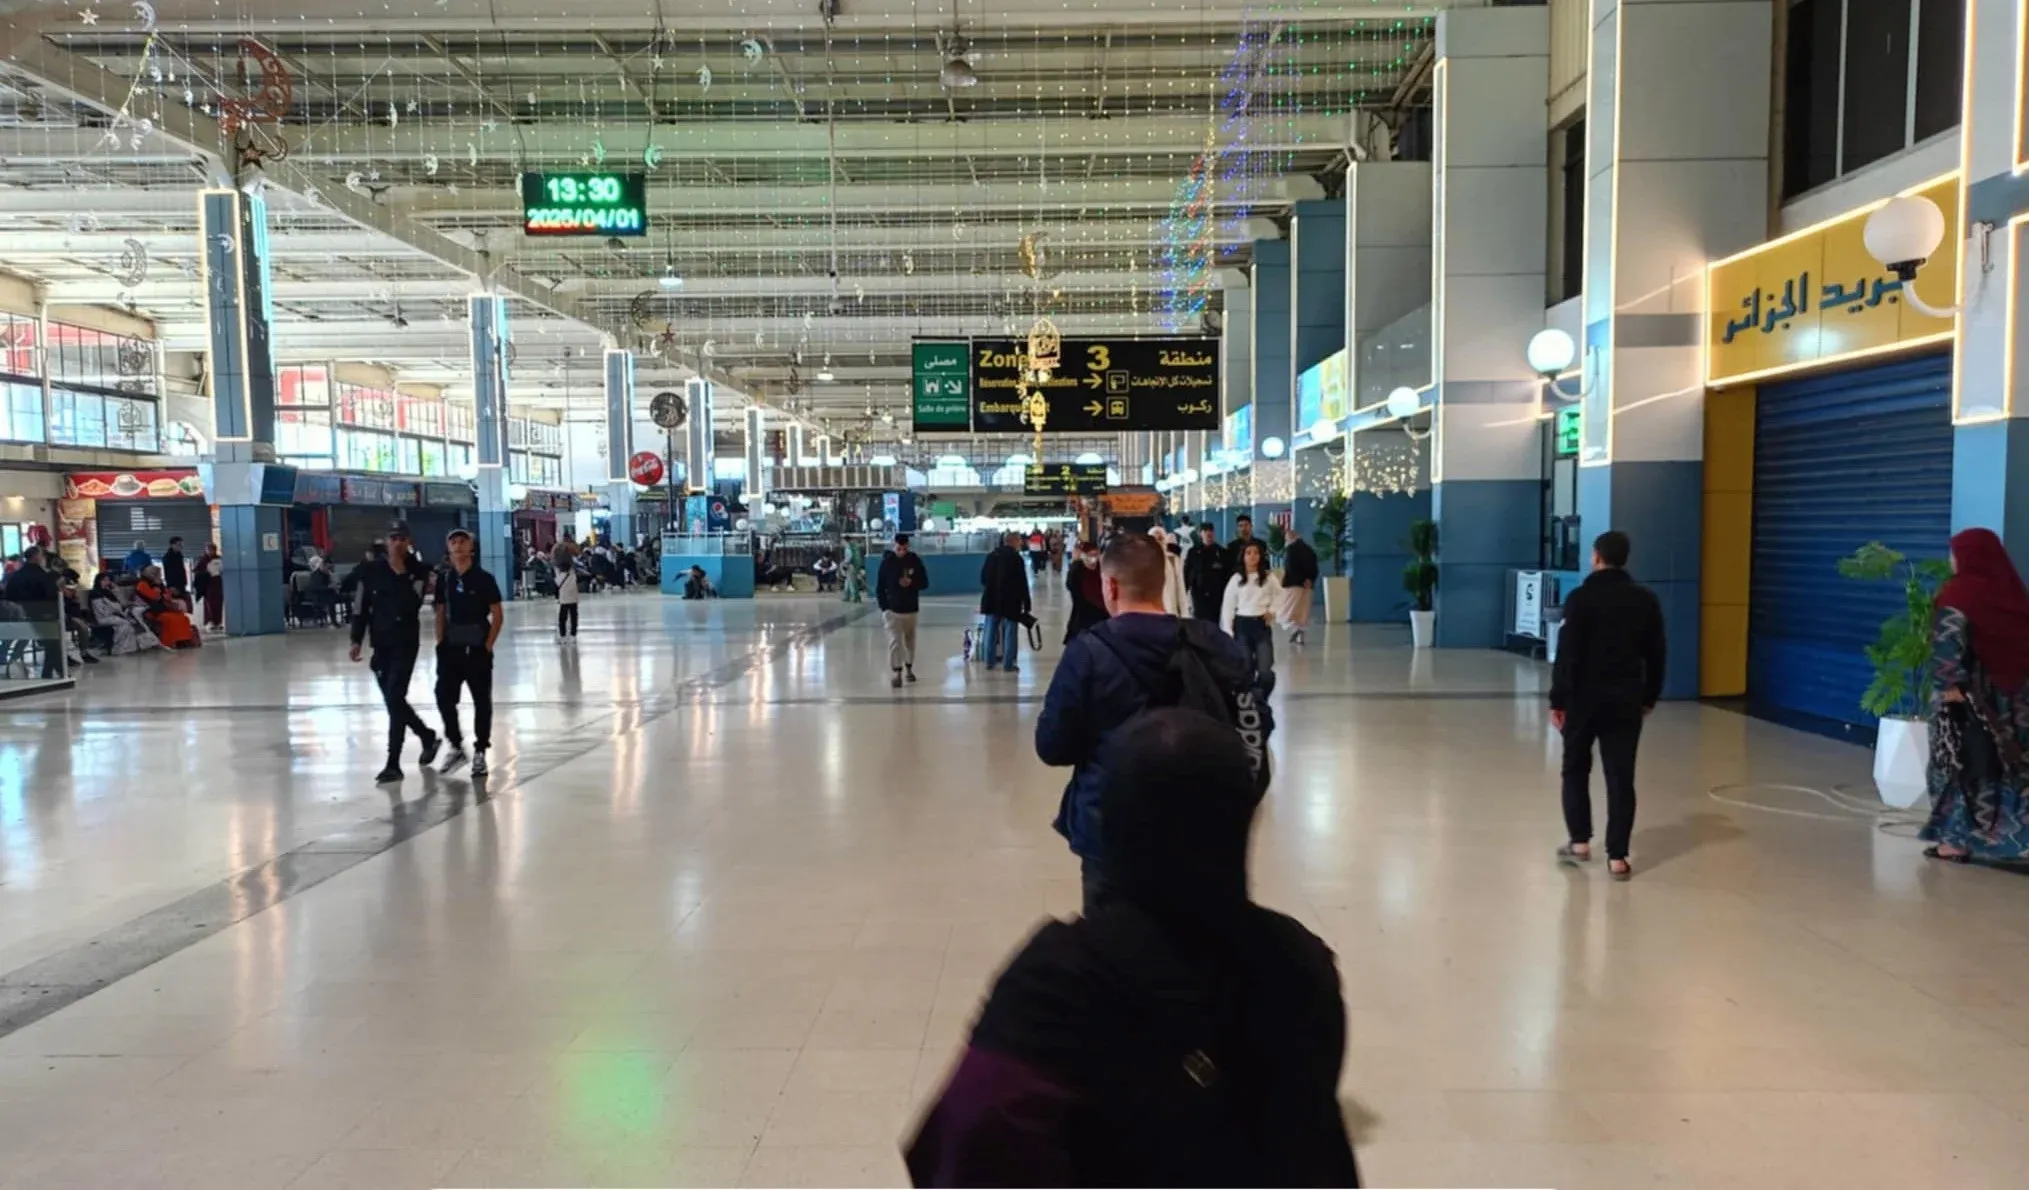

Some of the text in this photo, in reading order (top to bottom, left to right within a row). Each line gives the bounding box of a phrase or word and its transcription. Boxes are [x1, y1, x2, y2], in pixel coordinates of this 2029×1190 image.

[547, 176, 620, 203] 13:30
[526, 207, 640, 230] 2025/04/01
[1722, 271, 1808, 344] الجزائر
[979, 345, 1110, 371] Zone 3
[1159, 349, 1213, 367] منطقة
[918, 404, 934, 413] Salle
[936, 404, 944, 413] de
[1177, 399, 1213, 414] ركوب
[1060, 465, 1071, 476] 2
